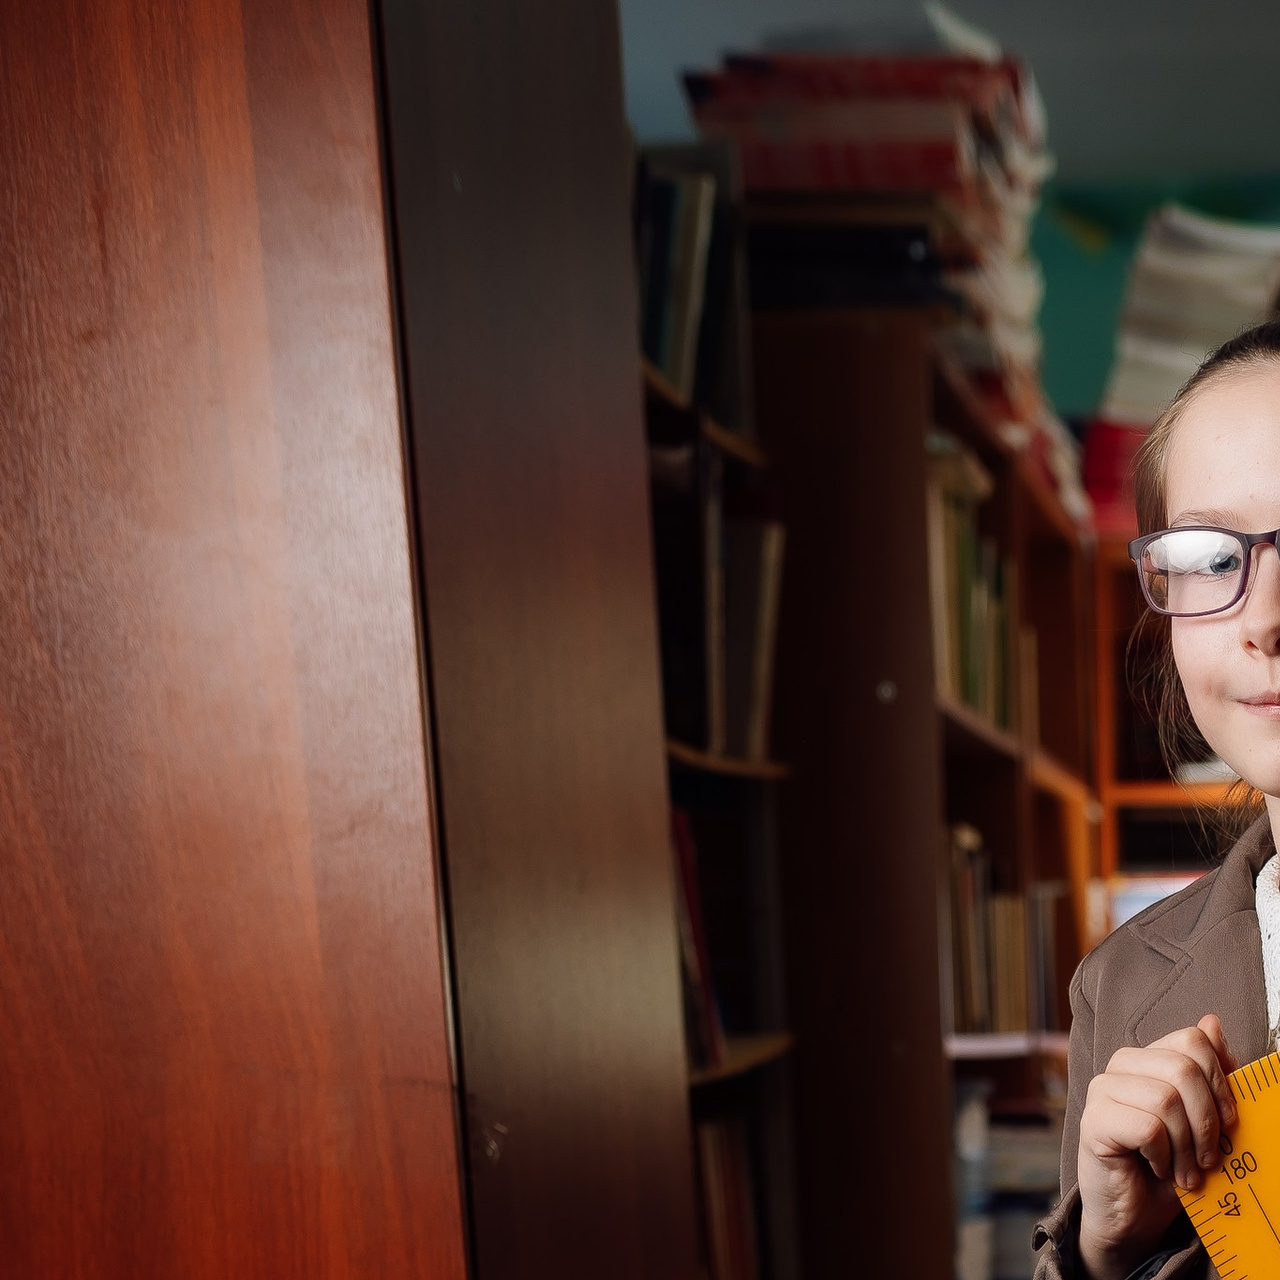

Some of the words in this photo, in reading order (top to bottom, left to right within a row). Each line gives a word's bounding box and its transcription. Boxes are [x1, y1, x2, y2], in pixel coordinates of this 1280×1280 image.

[1219, 1134, 1234, 1156] 0
[1220, 1151, 1258, 1185] 180
[1217, 1191, 1242, 1217] 45
